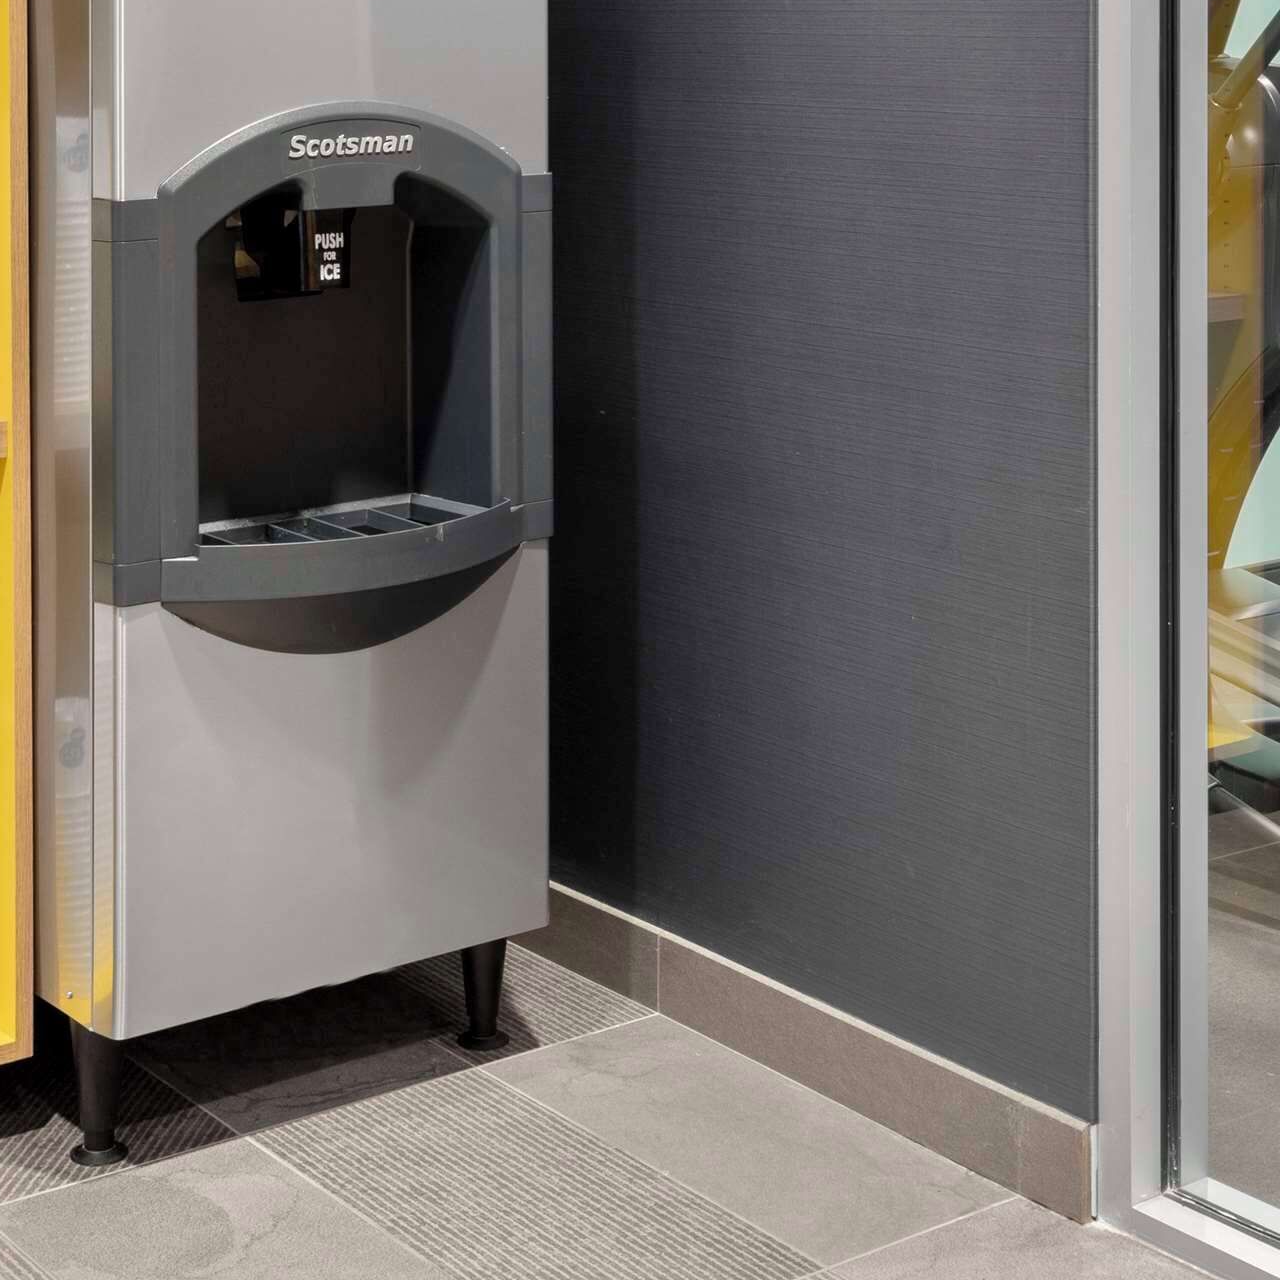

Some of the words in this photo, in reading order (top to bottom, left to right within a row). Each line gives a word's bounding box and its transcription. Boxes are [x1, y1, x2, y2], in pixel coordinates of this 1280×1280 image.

[289, 133, 414, 159] Scotsman
[315, 232, 344, 250] PUSH
[323, 251, 336, 261] FOR
[320, 263, 340, 280] ICE
